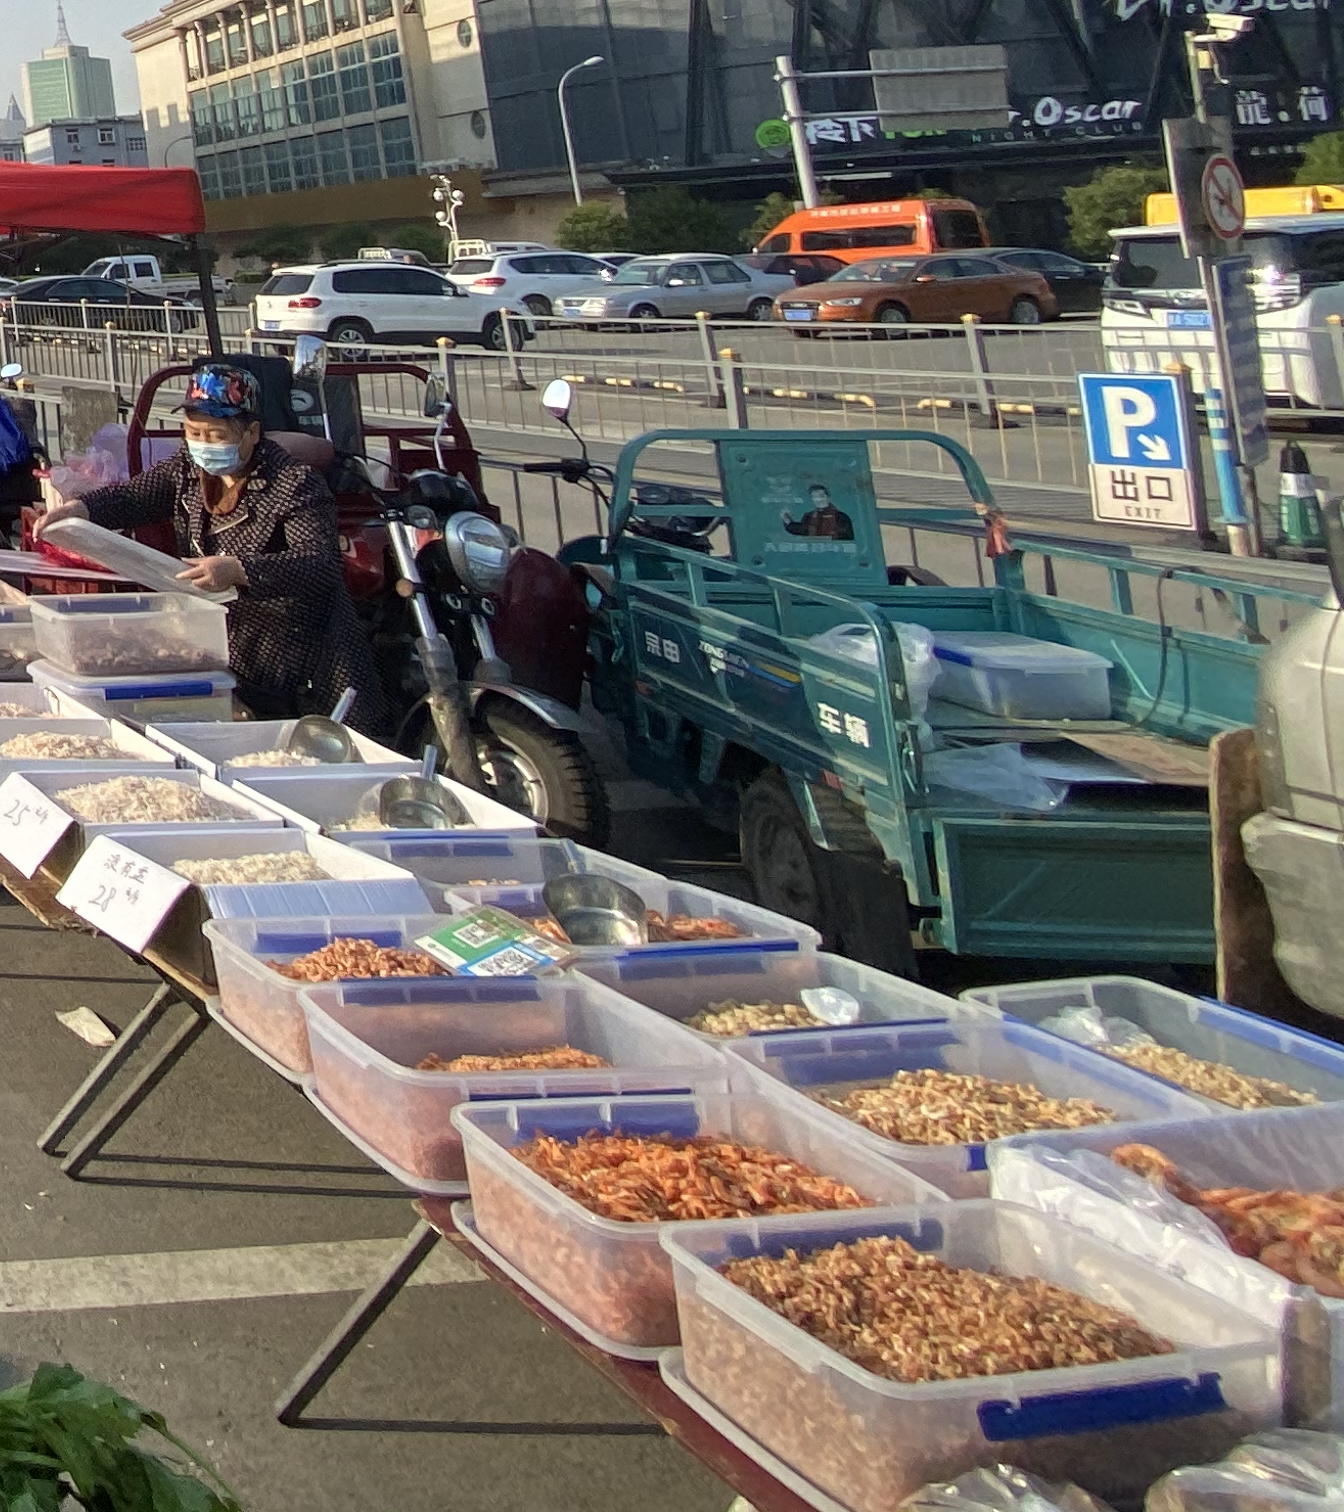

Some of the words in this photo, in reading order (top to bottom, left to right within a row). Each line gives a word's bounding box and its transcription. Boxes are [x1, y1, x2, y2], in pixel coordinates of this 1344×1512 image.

[971, 128, 1052, 143] NIGHT
[1075, 121, 1143, 135] CLUB
[1101, 386, 1157, 458] P
[1111, 468, 1173, 502] 出口
[1124, 505, 1161, 519] EXIT
[644, 630, 681, 664] 宗申
[816, 701, 871, 749] 车辆
